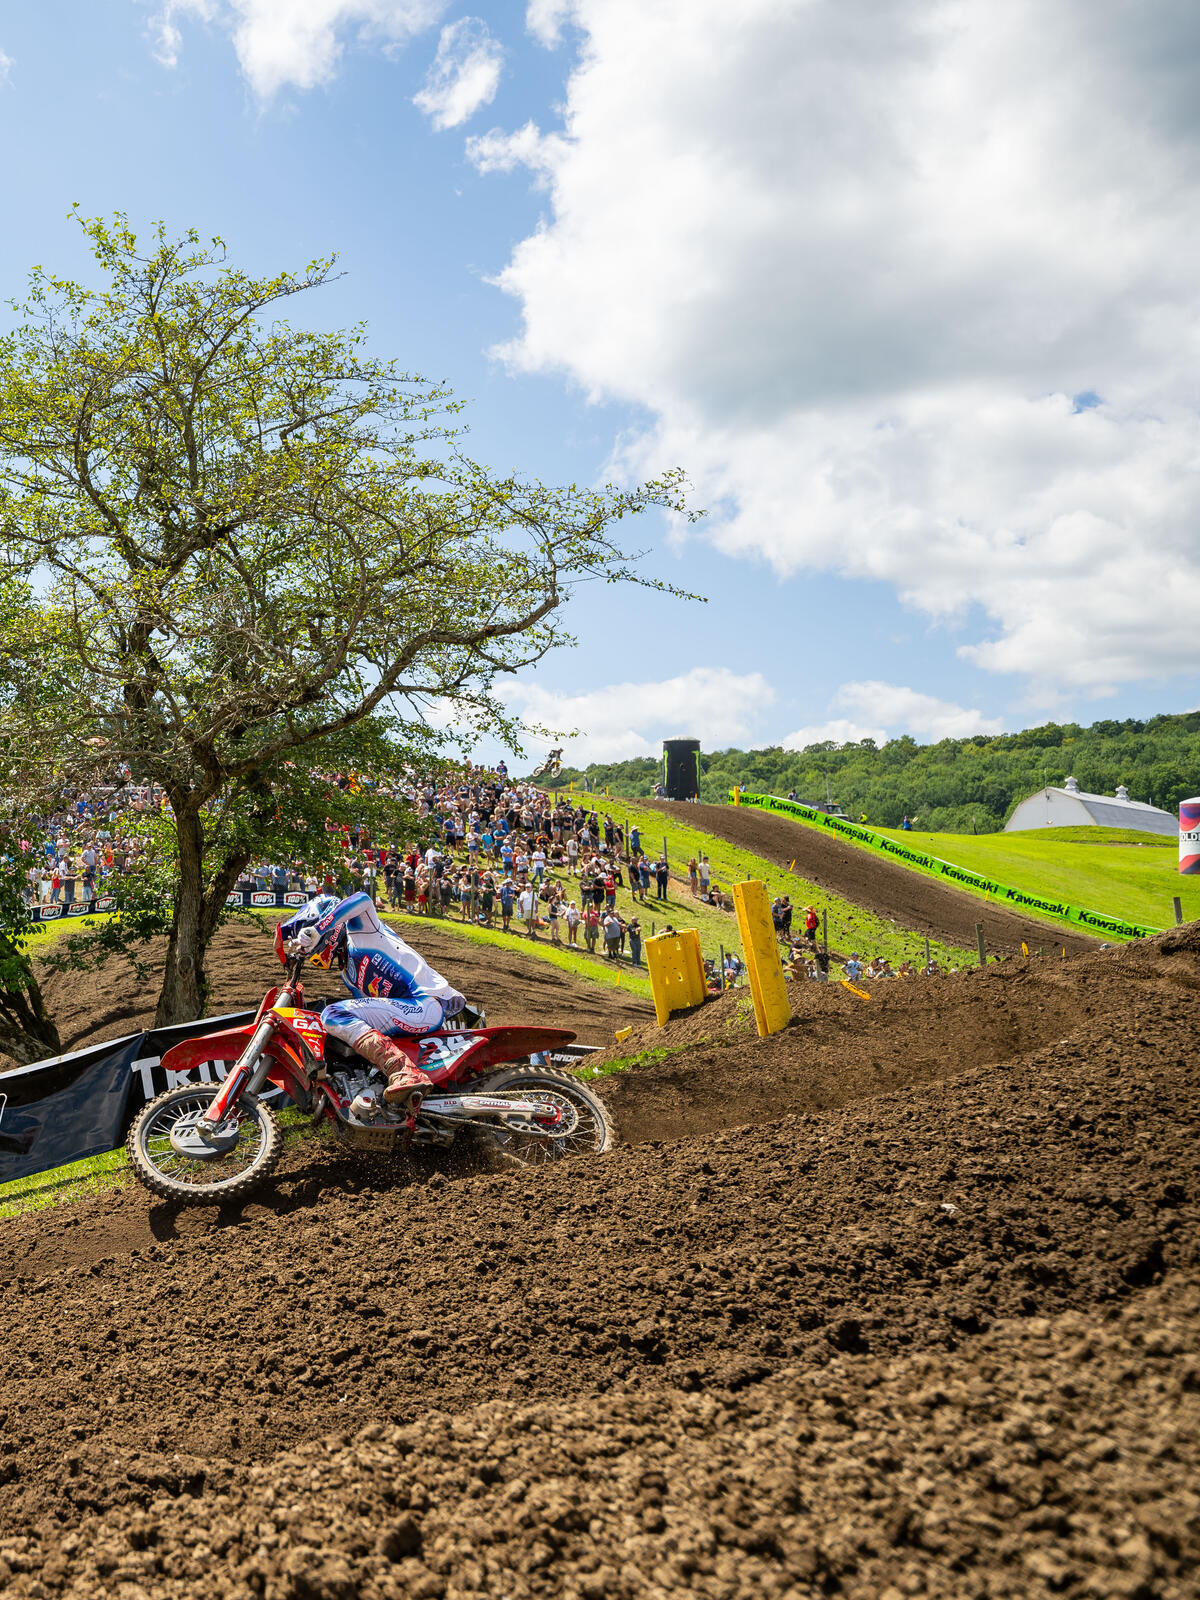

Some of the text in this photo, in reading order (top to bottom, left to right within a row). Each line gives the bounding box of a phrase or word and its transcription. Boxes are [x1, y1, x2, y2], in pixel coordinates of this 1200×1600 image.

[728, 795, 764, 806] asaki
[770, 799, 817, 821] Kawasaki
[823, 817, 874, 844] Kawasaki
[880, 840, 934, 869] Kawasaki
[941, 865, 999, 893] Kawasaki
[255, 894, 273, 904] 100%
[287, 895, 306, 904] 100%
[1006, 889, 1070, 916] Kawasaki
[1078, 911, 1147, 938] Kawasaki
